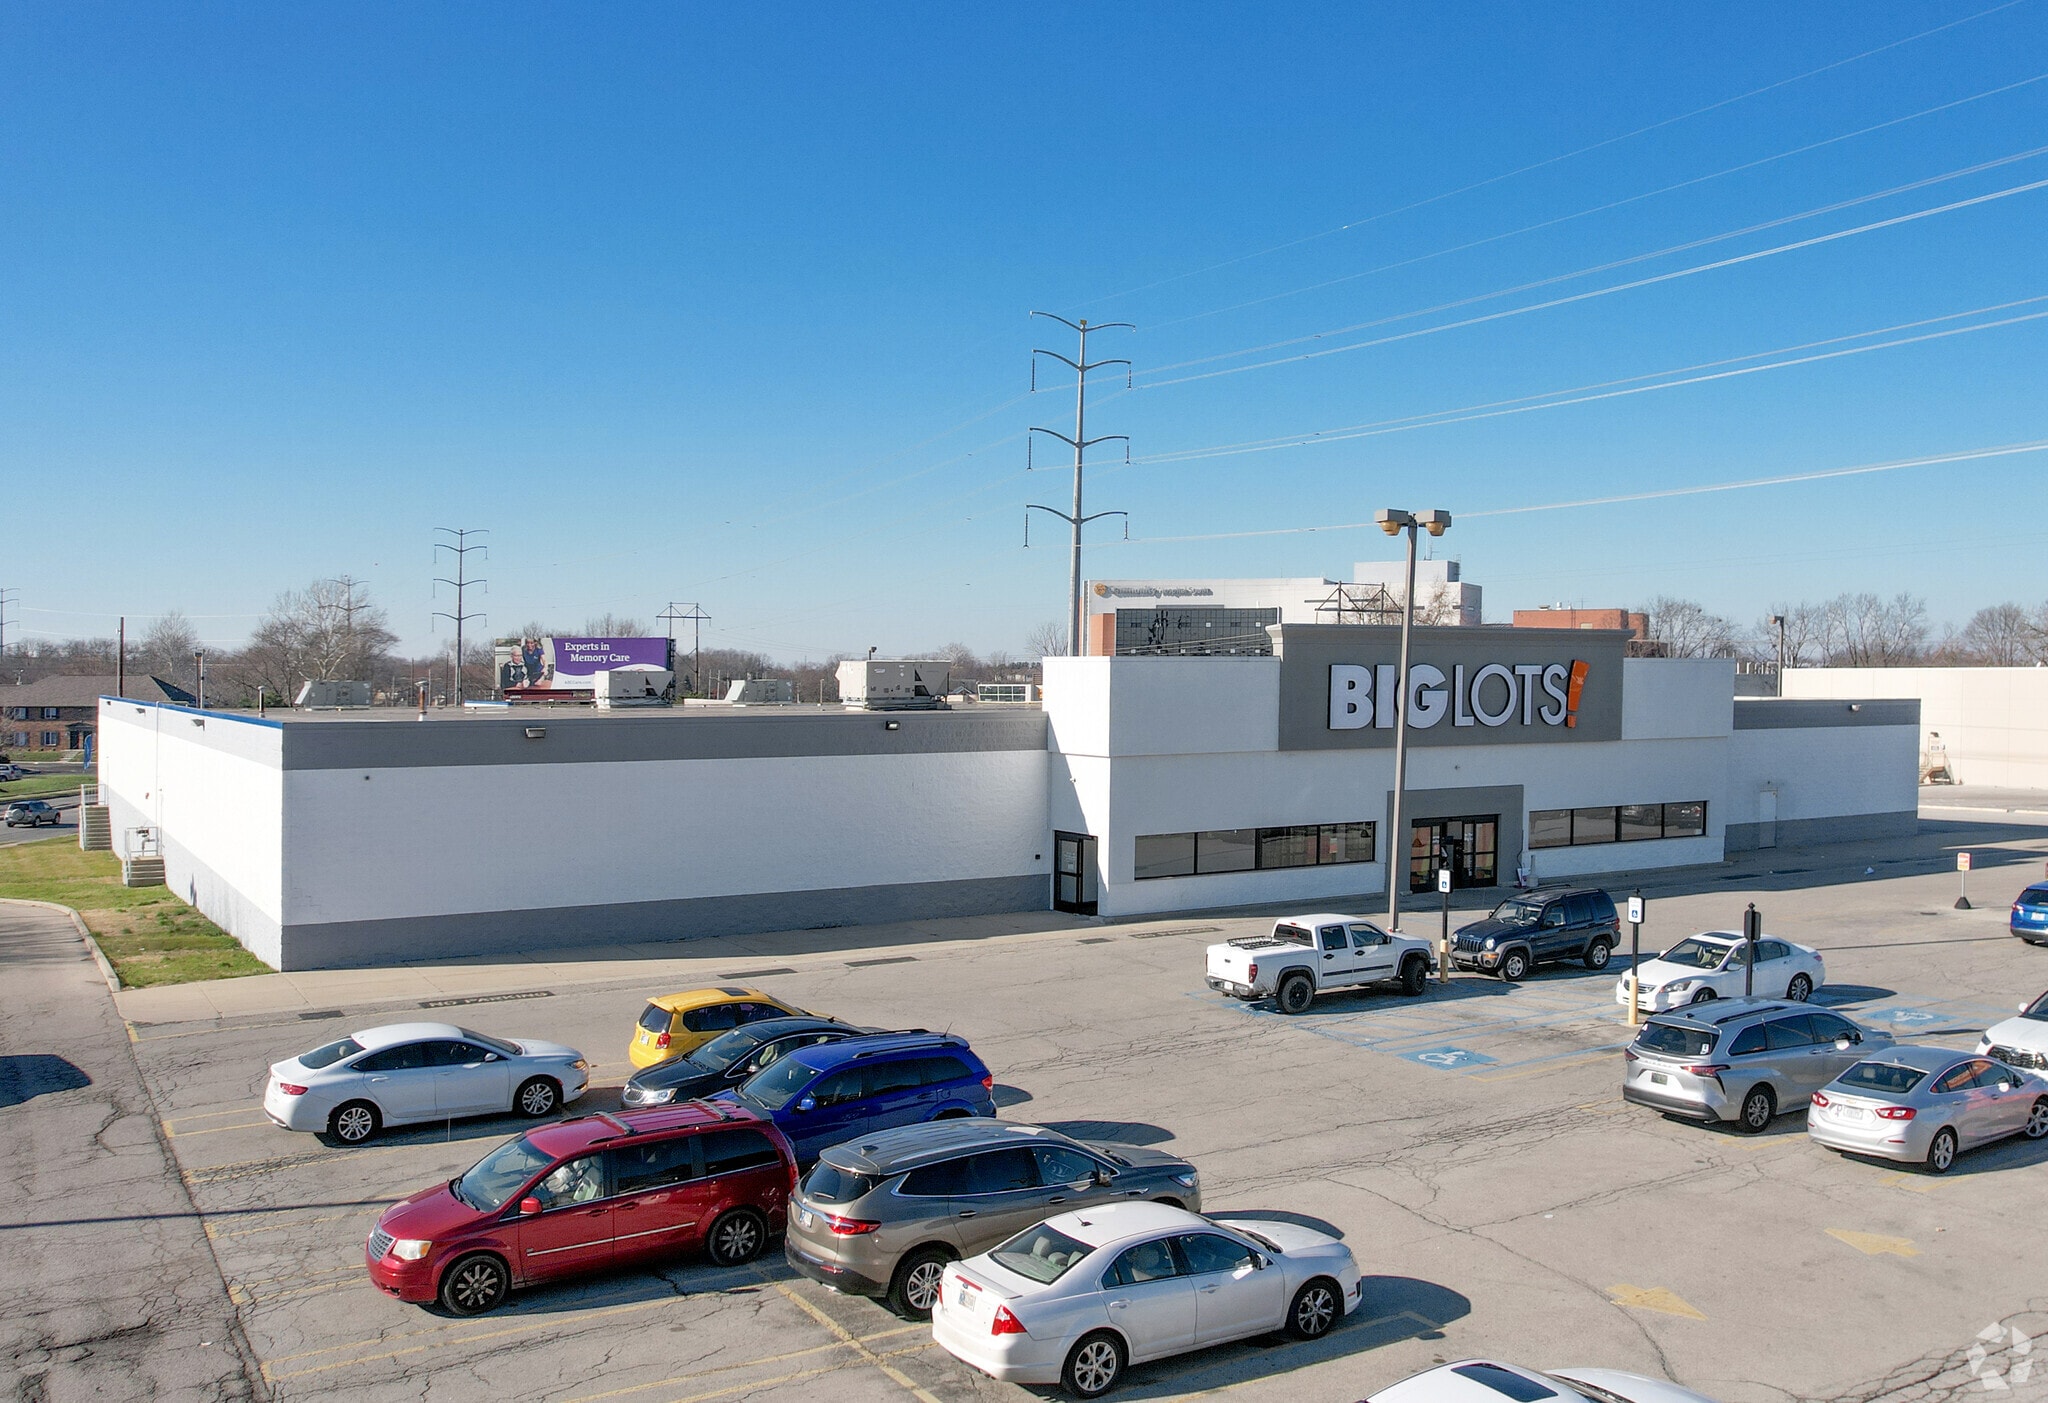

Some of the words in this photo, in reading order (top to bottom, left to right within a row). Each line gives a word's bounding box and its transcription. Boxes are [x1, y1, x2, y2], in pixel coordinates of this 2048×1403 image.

[564, 642, 599, 653] Experts
[600, 641, 610, 651] in
[570, 653, 608, 664] Memory
[609, 653, 630, 662] Care
[428, 1000, 458, 1008] NO
[464, 991, 549, 1004] PARKING
